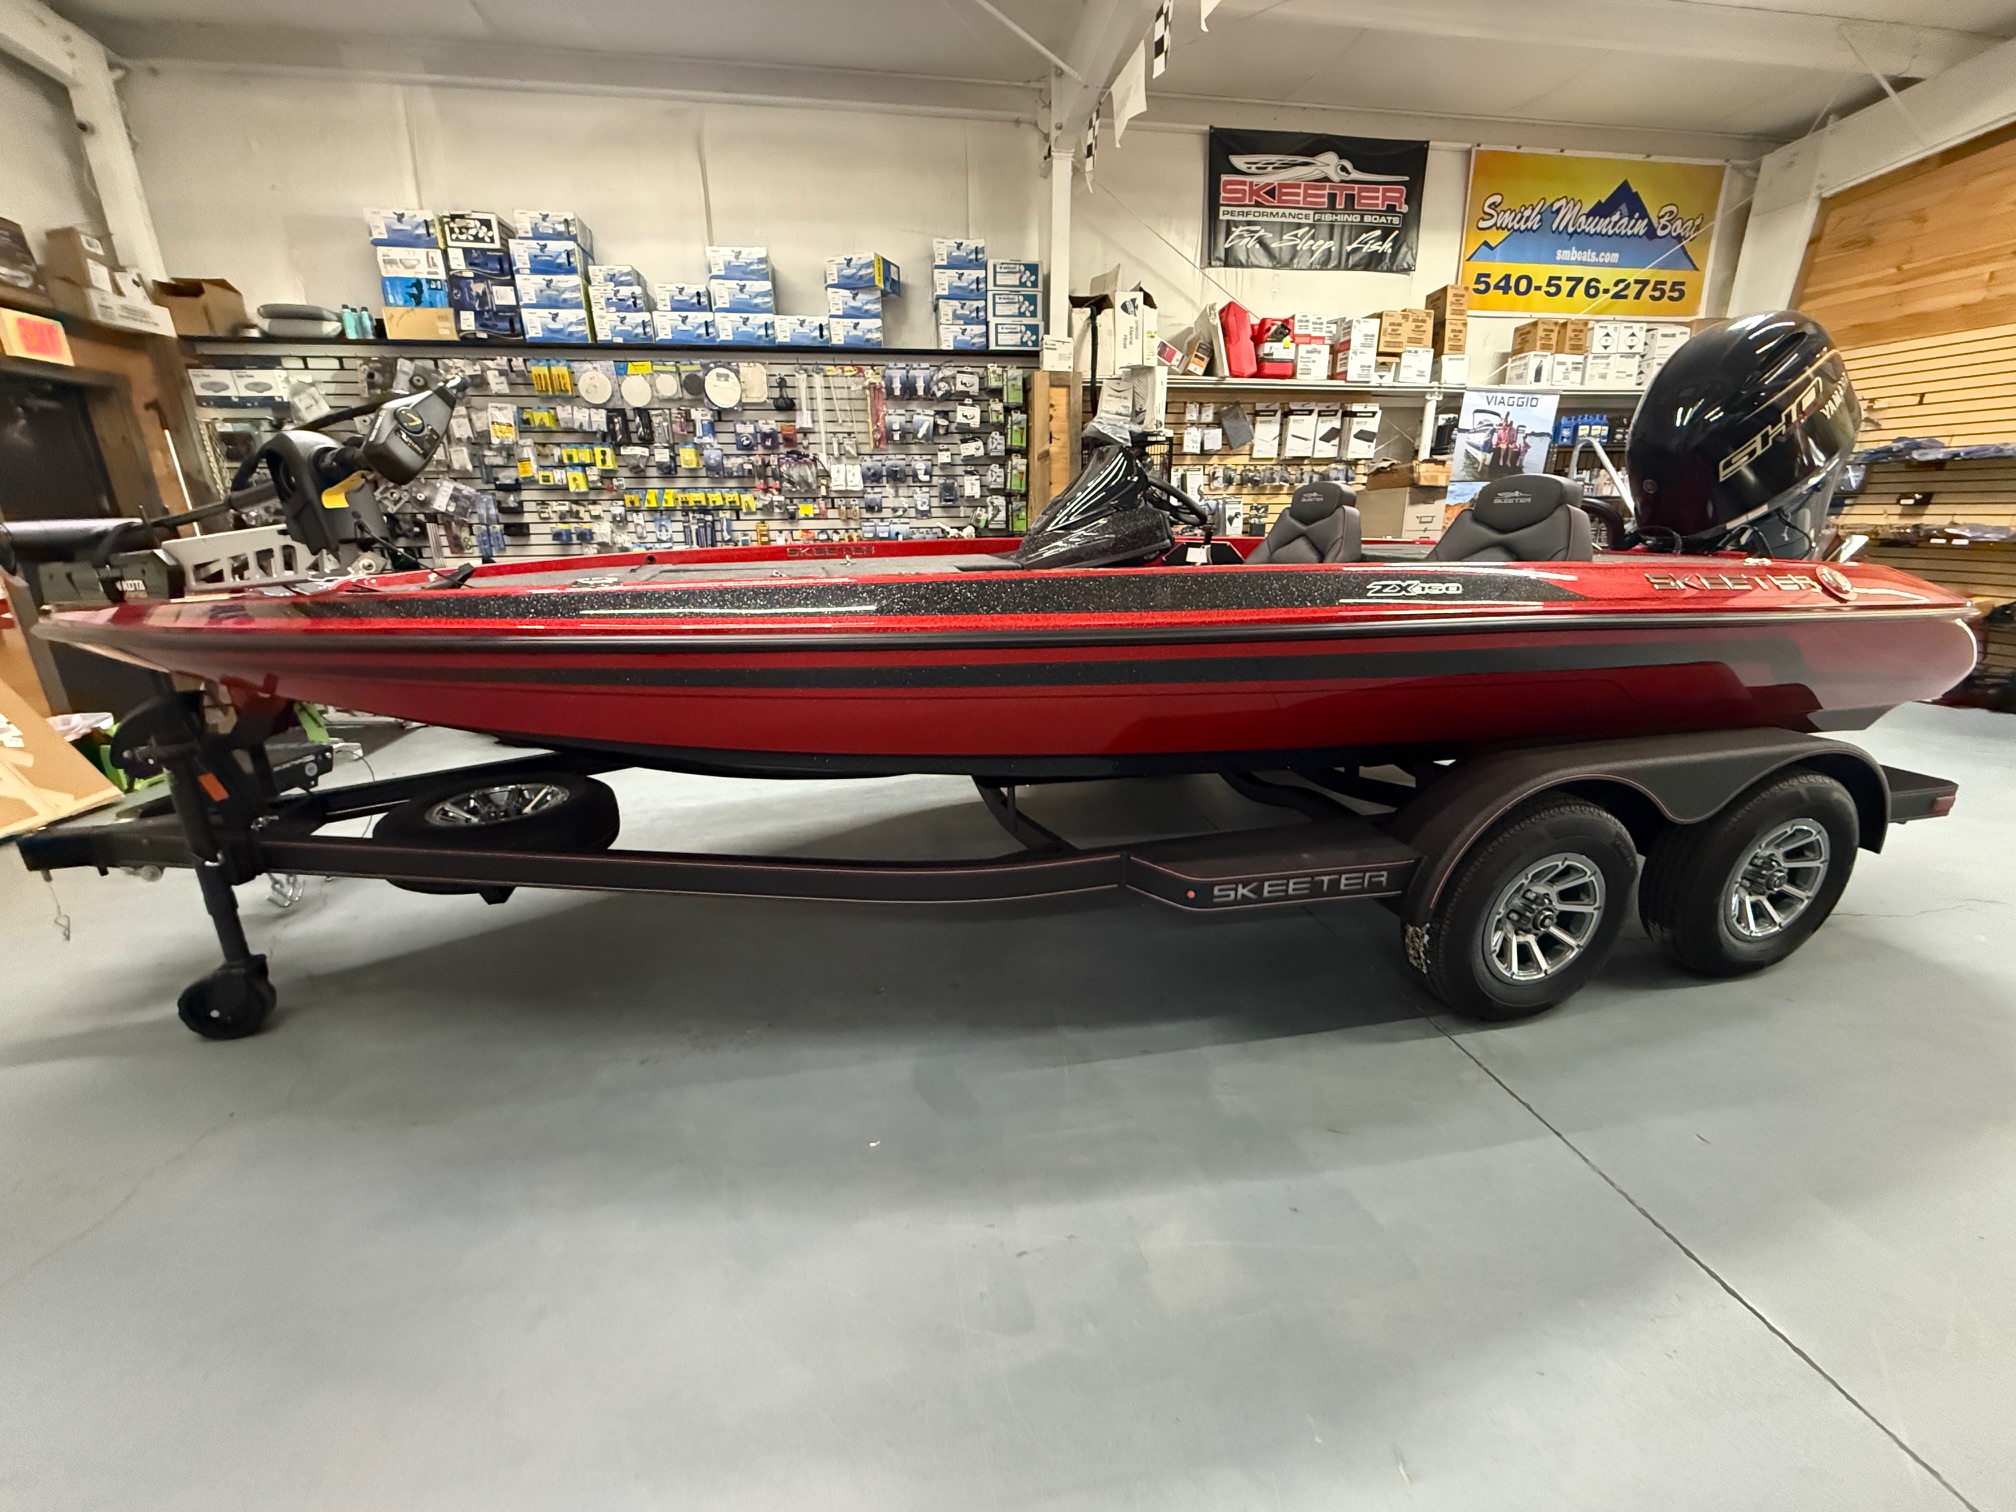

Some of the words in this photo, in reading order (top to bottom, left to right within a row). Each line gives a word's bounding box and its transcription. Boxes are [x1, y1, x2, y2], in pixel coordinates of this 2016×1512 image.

[1220, 179, 1406, 212] SKEETER
[1222, 209, 1311, 220] PERFORMANCE
[1314, 213, 1360, 222] FISHING
[1364, 215, 1400, 225] BOATS
[1476, 193, 1546, 232] Smith
[1550, 195, 1648, 240] Mountain
[1271, 226, 1336, 264] Sleep.
[1346, 230, 1399, 254] Fish.
[1556, 247, 1619, 263] smboats.com
[1472, 272, 1686, 302] 540-576-2755
[1486, 395, 1539, 408] VIAGGIO
[787, 546, 875, 557] SKEETER
[1644, 573, 1822, 593] SKEETER
[1213, 871, 1388, 902] SKEETER
